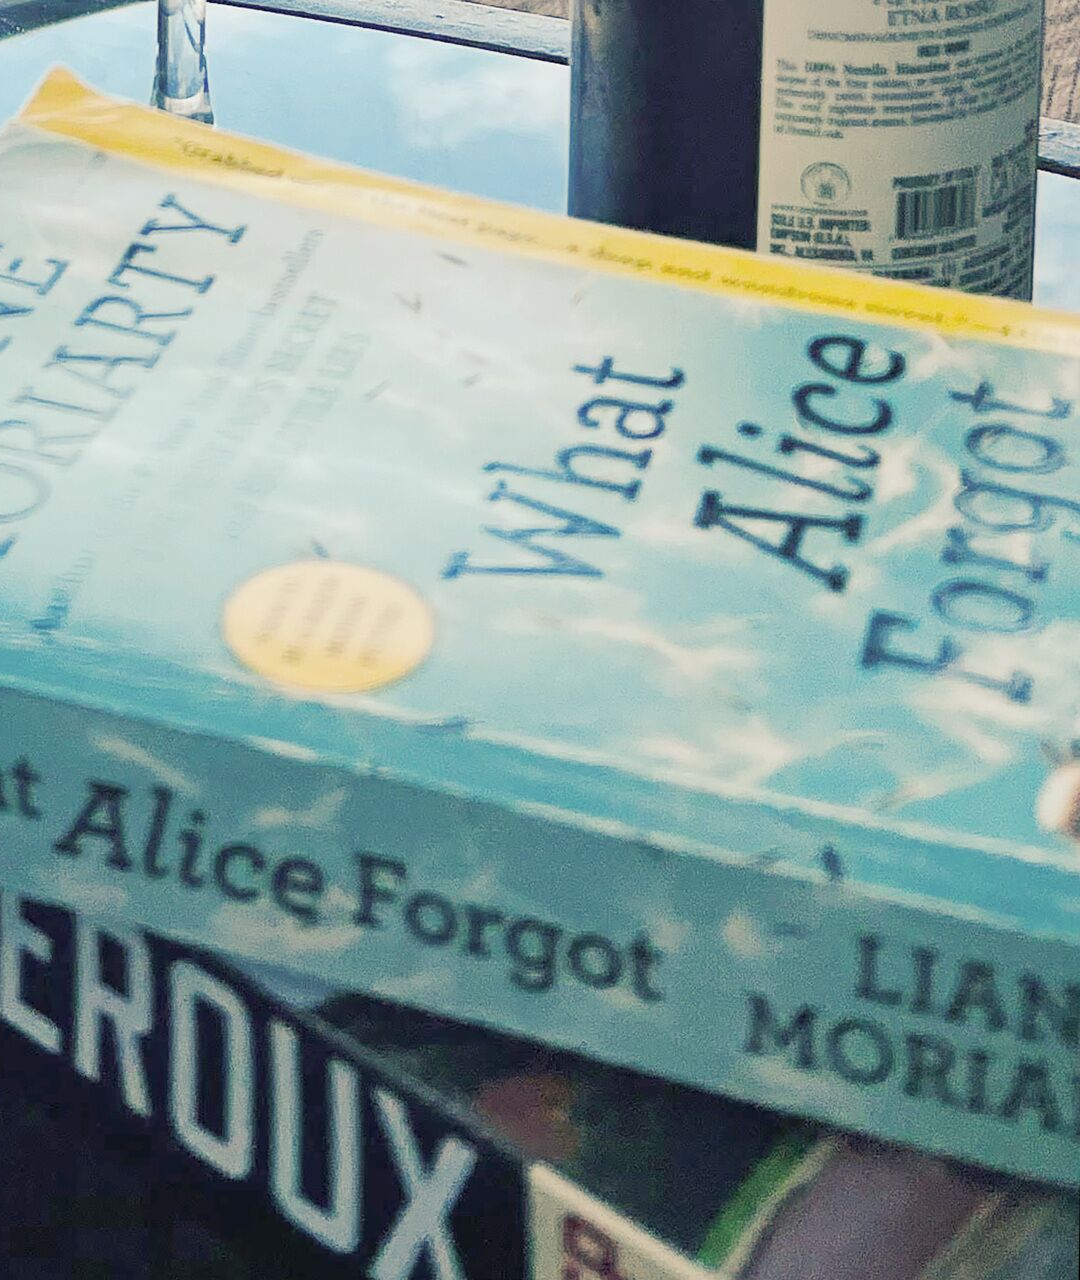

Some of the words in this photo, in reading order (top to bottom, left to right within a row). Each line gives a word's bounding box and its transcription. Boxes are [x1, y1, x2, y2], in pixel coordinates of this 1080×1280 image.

[439, 355, 687, 582] What
[692, 331, 906, 594] Alice
[856, 379, 1080, 705] Forgot
[53, 778, 328, 928] Alice
[353, 851, 663, 1002] Forgot
[743, 990, 1080, 1135] MORIA
